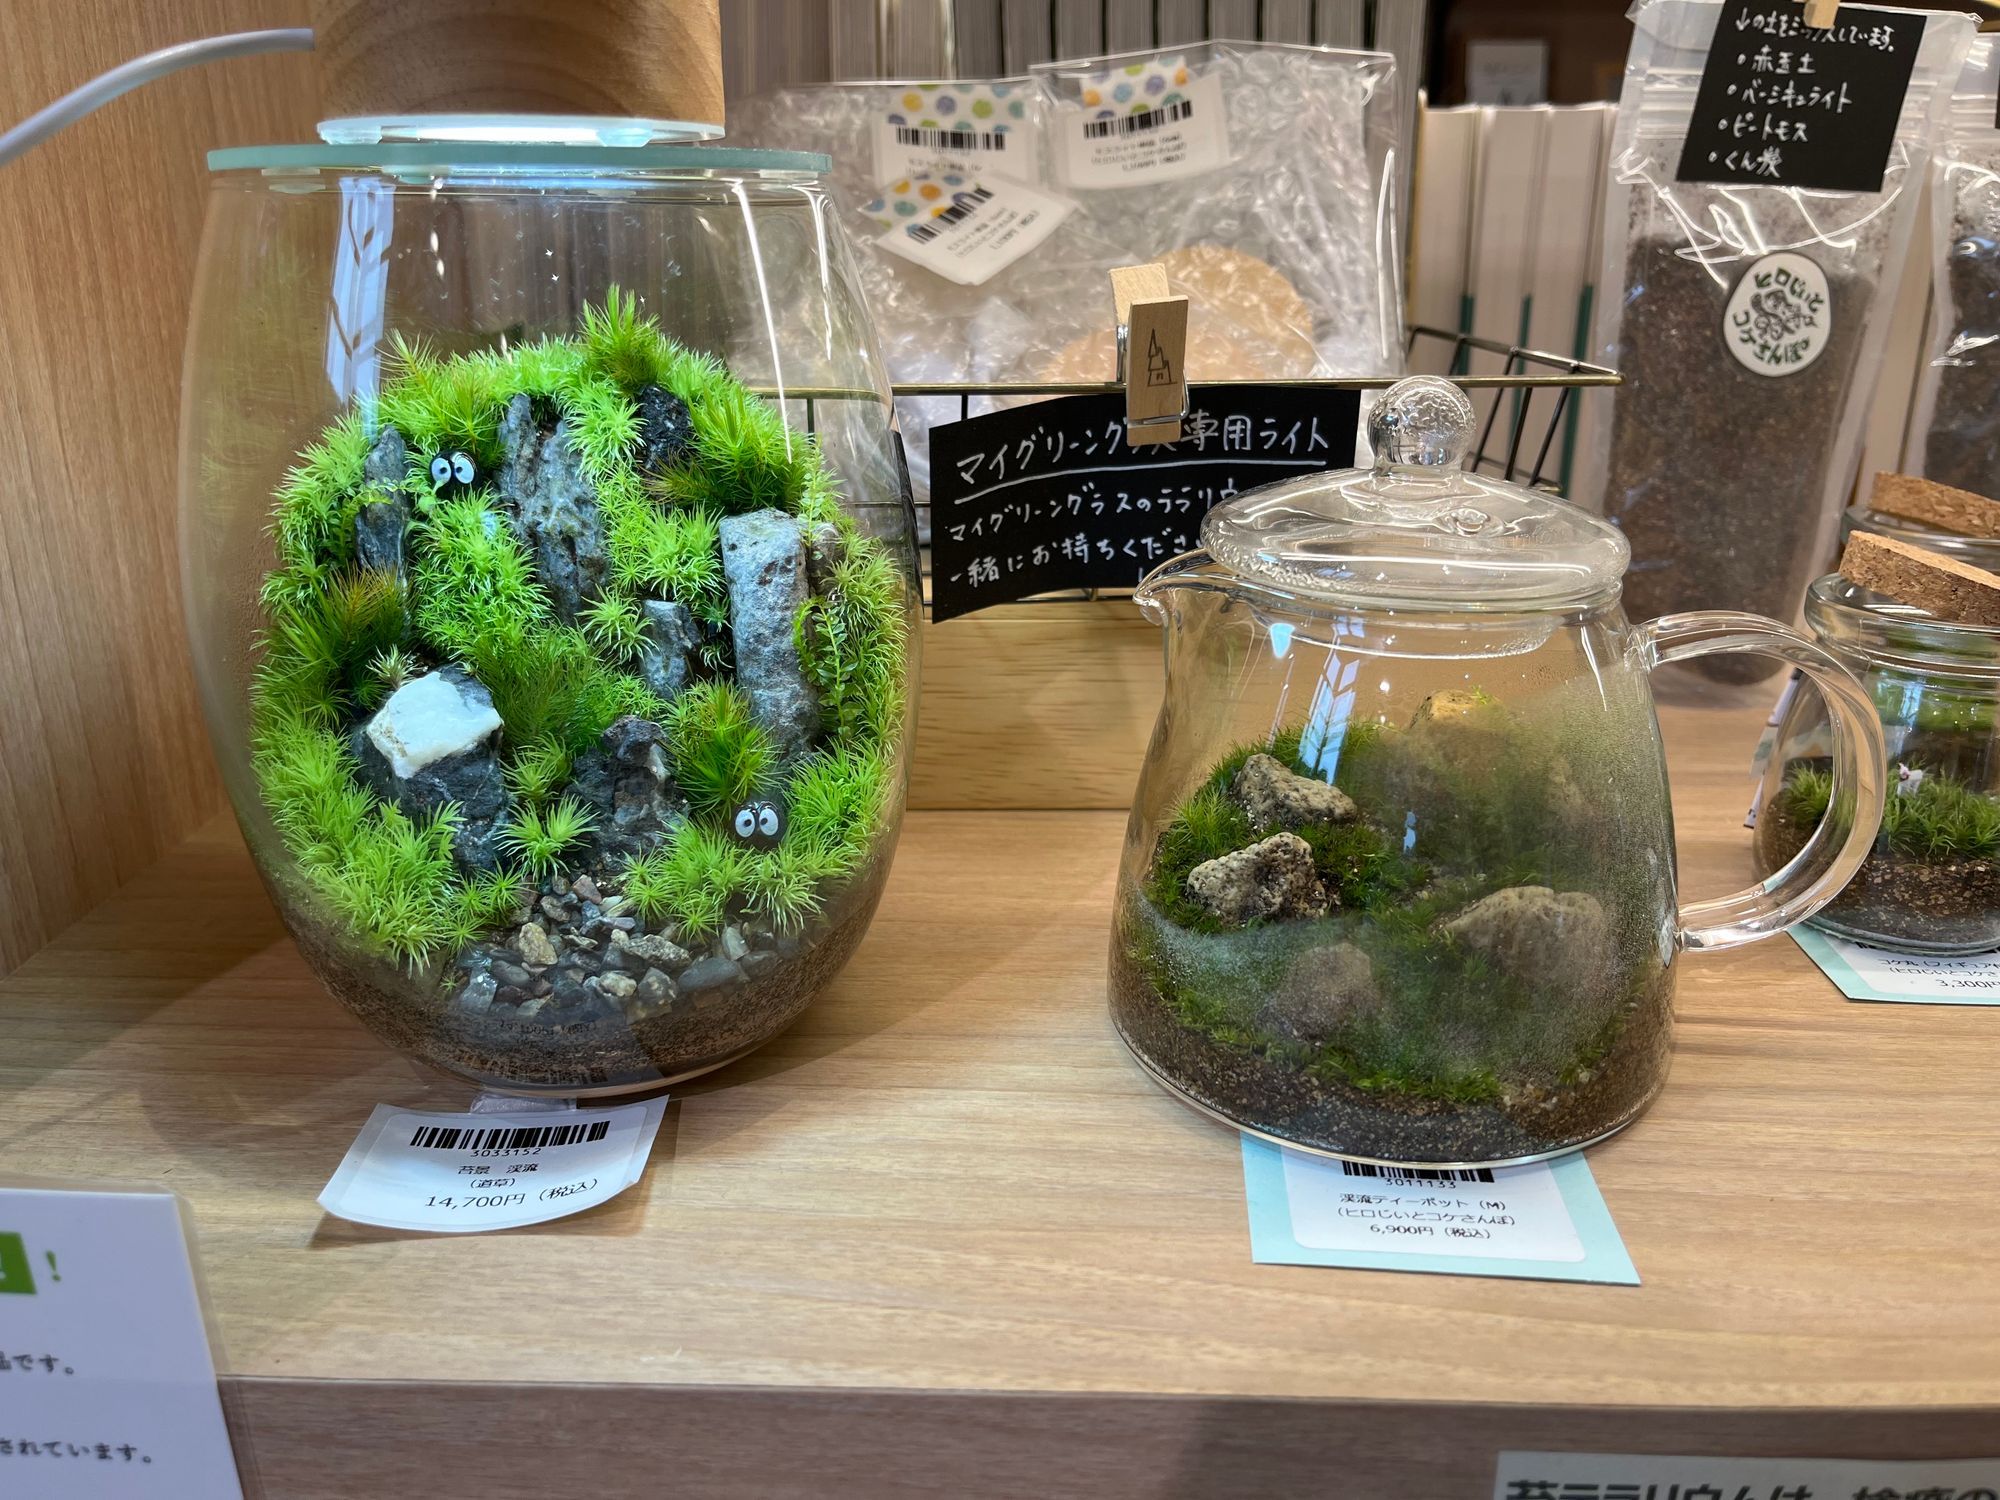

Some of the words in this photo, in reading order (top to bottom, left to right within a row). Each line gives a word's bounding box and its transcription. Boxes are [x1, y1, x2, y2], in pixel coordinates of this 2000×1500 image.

[1752, 45, 1817, 75] 赤玉土
[1741, 79, 1852, 113] バーミキュライト
[1733, 111, 1809, 142] ピートモス
[1724, 145, 1783, 178] くん炭
[470, 1147, 542, 1157] 3033152
[1385, 1178, 1457, 1189] 3011133
